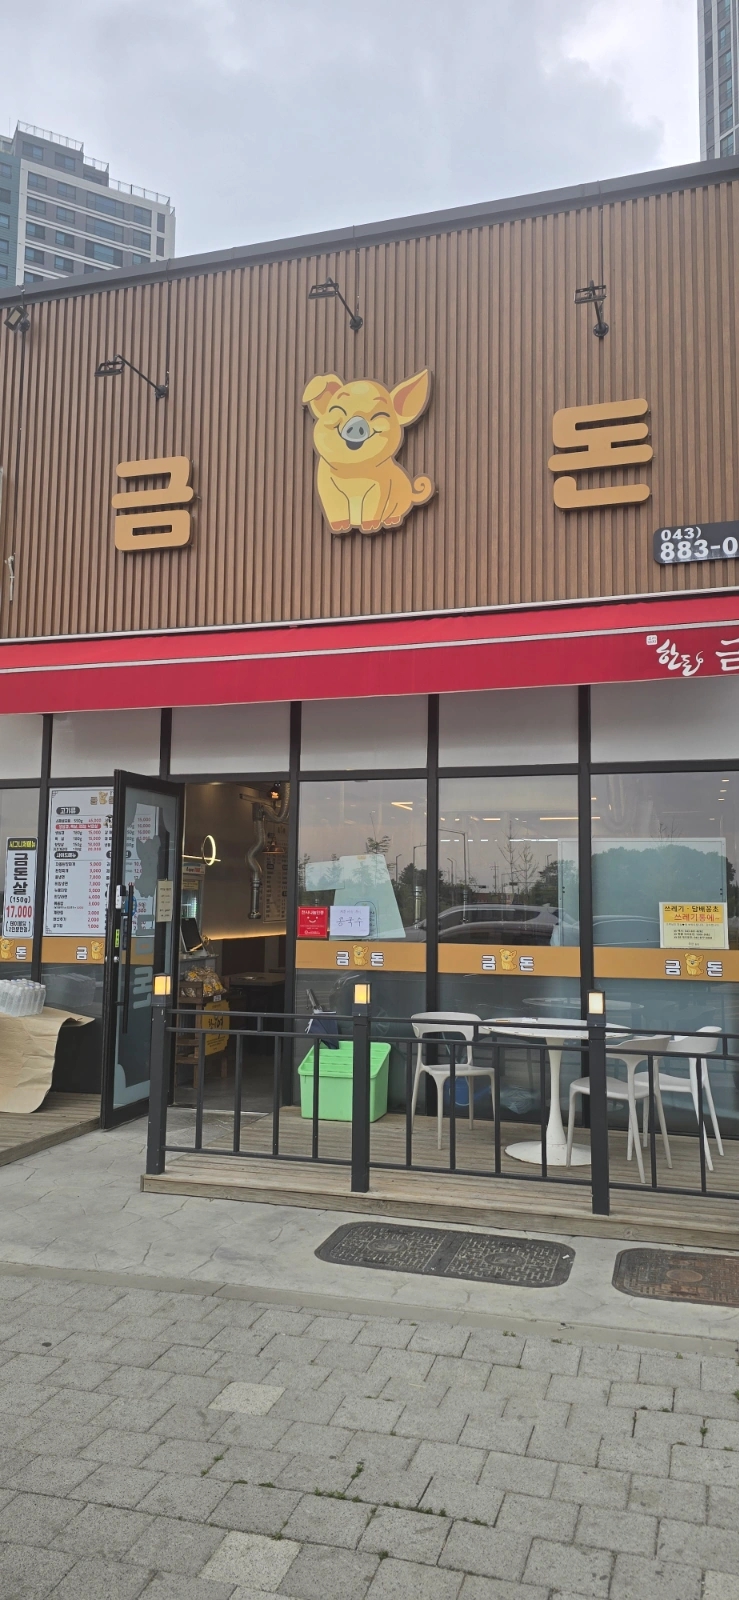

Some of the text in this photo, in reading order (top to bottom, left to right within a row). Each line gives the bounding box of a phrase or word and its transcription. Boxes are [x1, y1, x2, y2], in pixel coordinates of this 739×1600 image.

[111, 398, 653, 550] 금 돈
[660, 526, 701, 541] 043)
[13, 852, 28, 895] 금돈살
[9, 895, 31, 903] (150g)
[691, 905, 719, 913] 담배꽁초
[15, 946, 27, 960] 돈
[76, 946, 88, 960] 금
[336, 951, 385, 967] 금 돈
[481, 954, 534, 972] 금 돈
[665, 959, 723, 977] 금 돈
